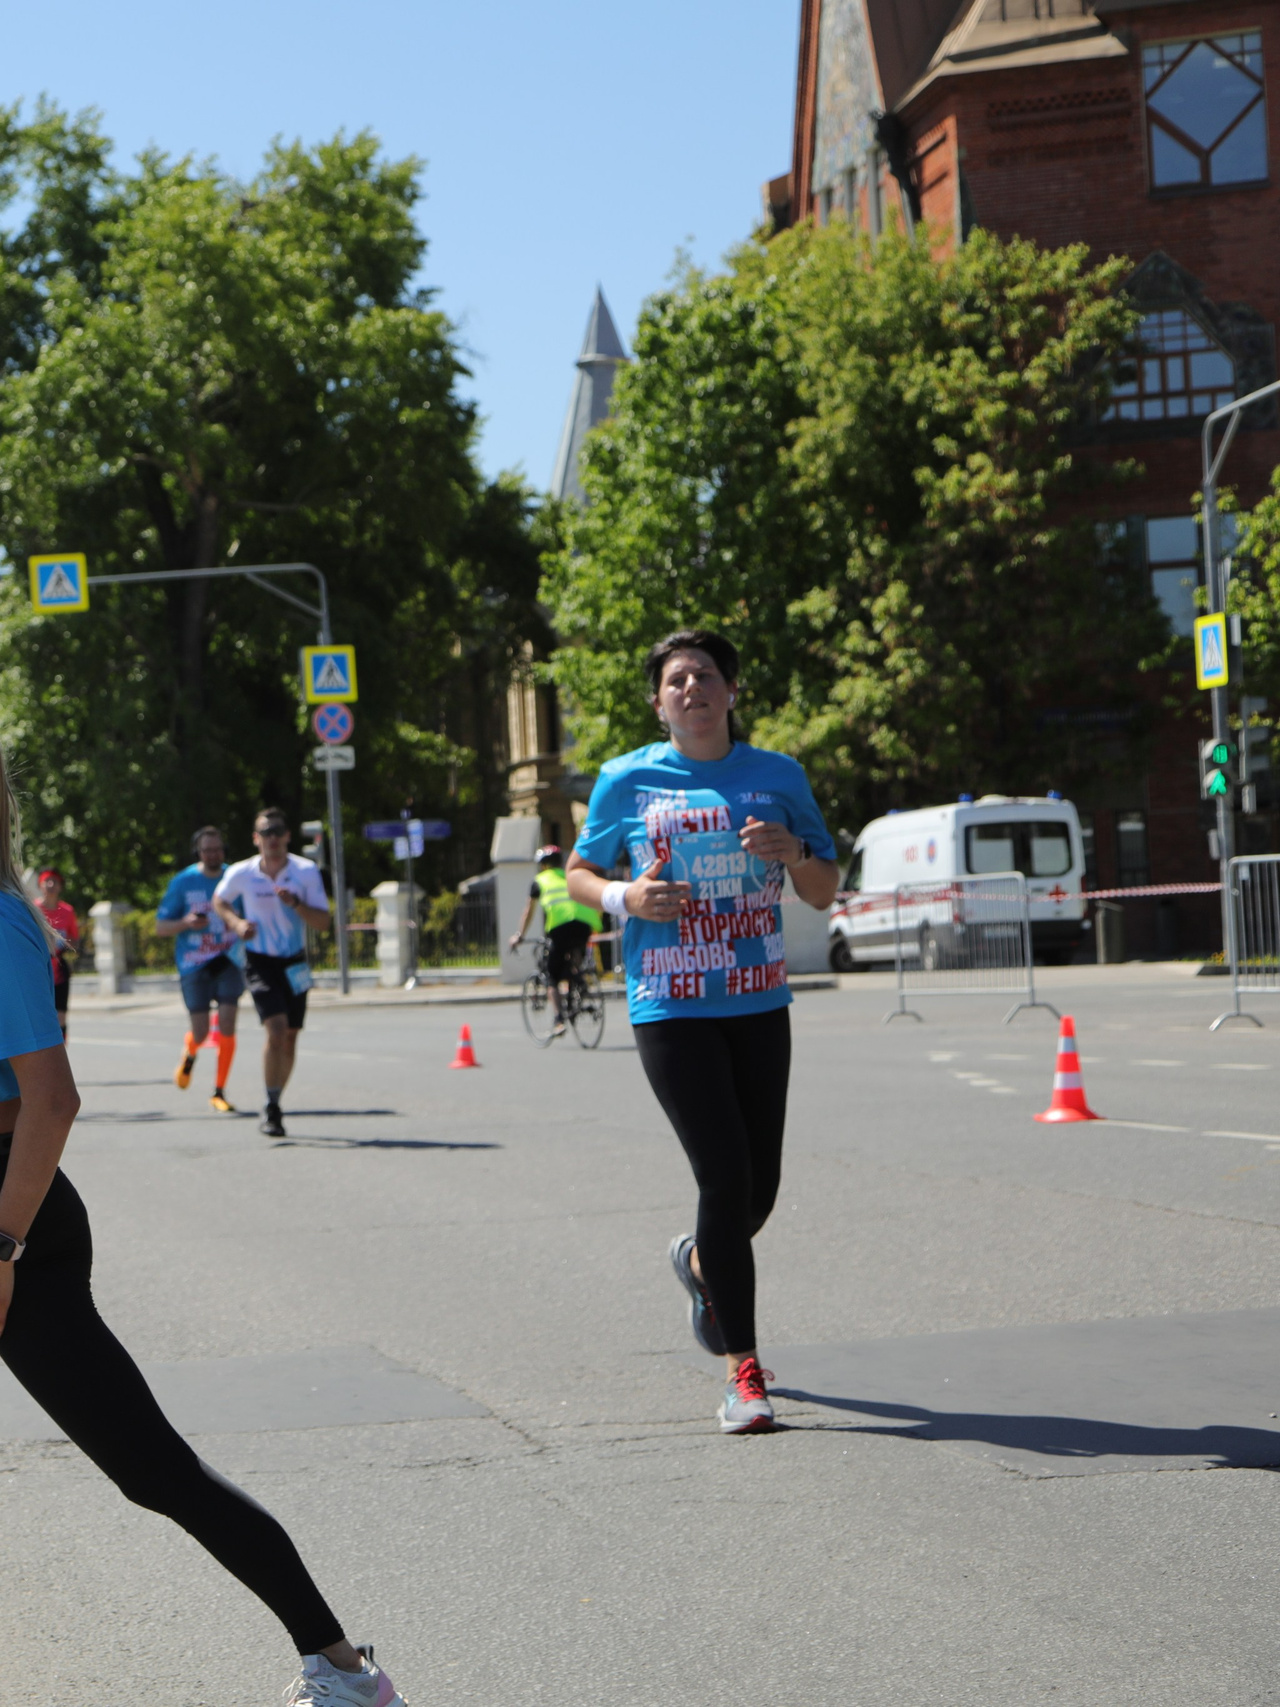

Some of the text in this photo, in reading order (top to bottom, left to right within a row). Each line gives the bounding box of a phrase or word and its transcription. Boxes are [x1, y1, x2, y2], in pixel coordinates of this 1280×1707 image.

[646, 805, 732, 839] #МЕЧТА
[691, 851, 747, 878] 42813
[678, 908, 776, 945] #ГОРДОСТЬ
[642, 942, 737, 976] #ЛЮБОВЬ
